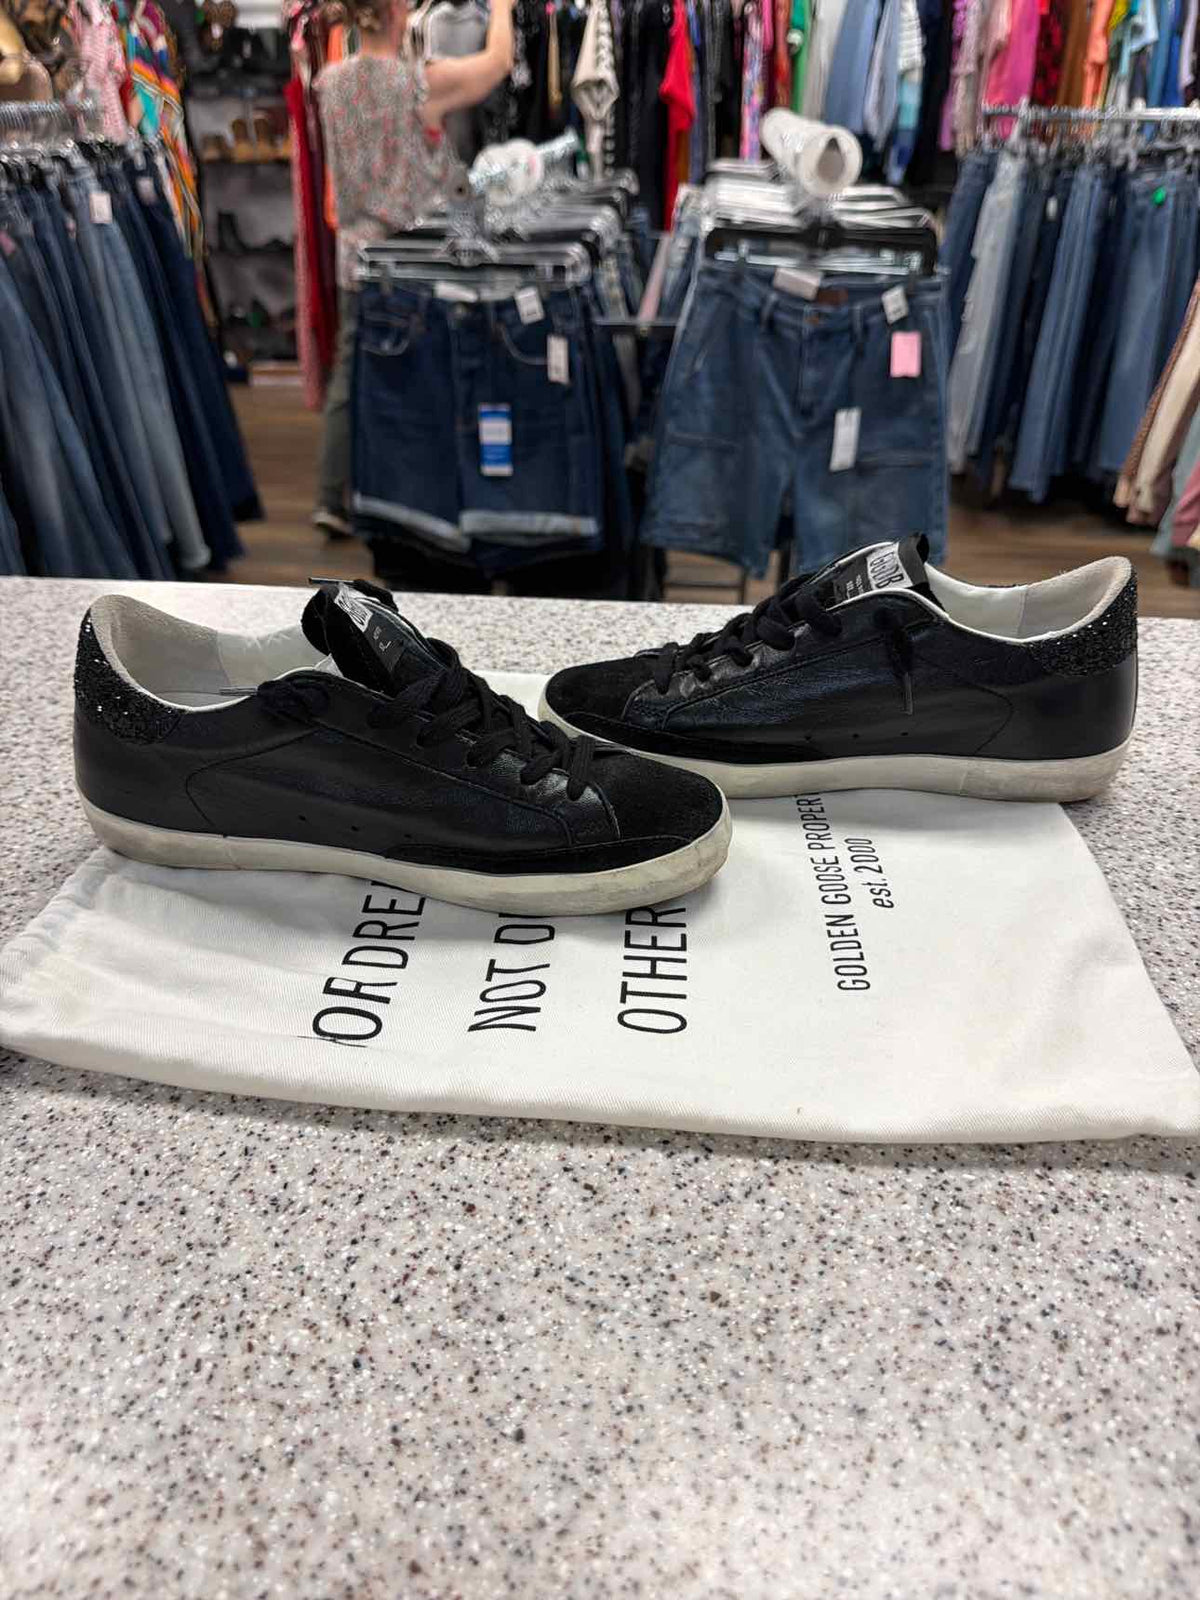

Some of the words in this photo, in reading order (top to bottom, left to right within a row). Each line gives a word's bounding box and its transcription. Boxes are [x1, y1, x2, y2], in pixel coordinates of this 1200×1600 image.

[810, 855, 852, 905] GOOSE
[844, 837, 883, 874] 2000
[342, 880, 427, 969] DRE
[861, 878, 895, 909] est.
[616, 905, 688, 1035] OTHER
[824, 914, 871, 991] GOLDEN
[303, 976, 398, 1046] OR
[467, 958, 551, 1032] NOT
